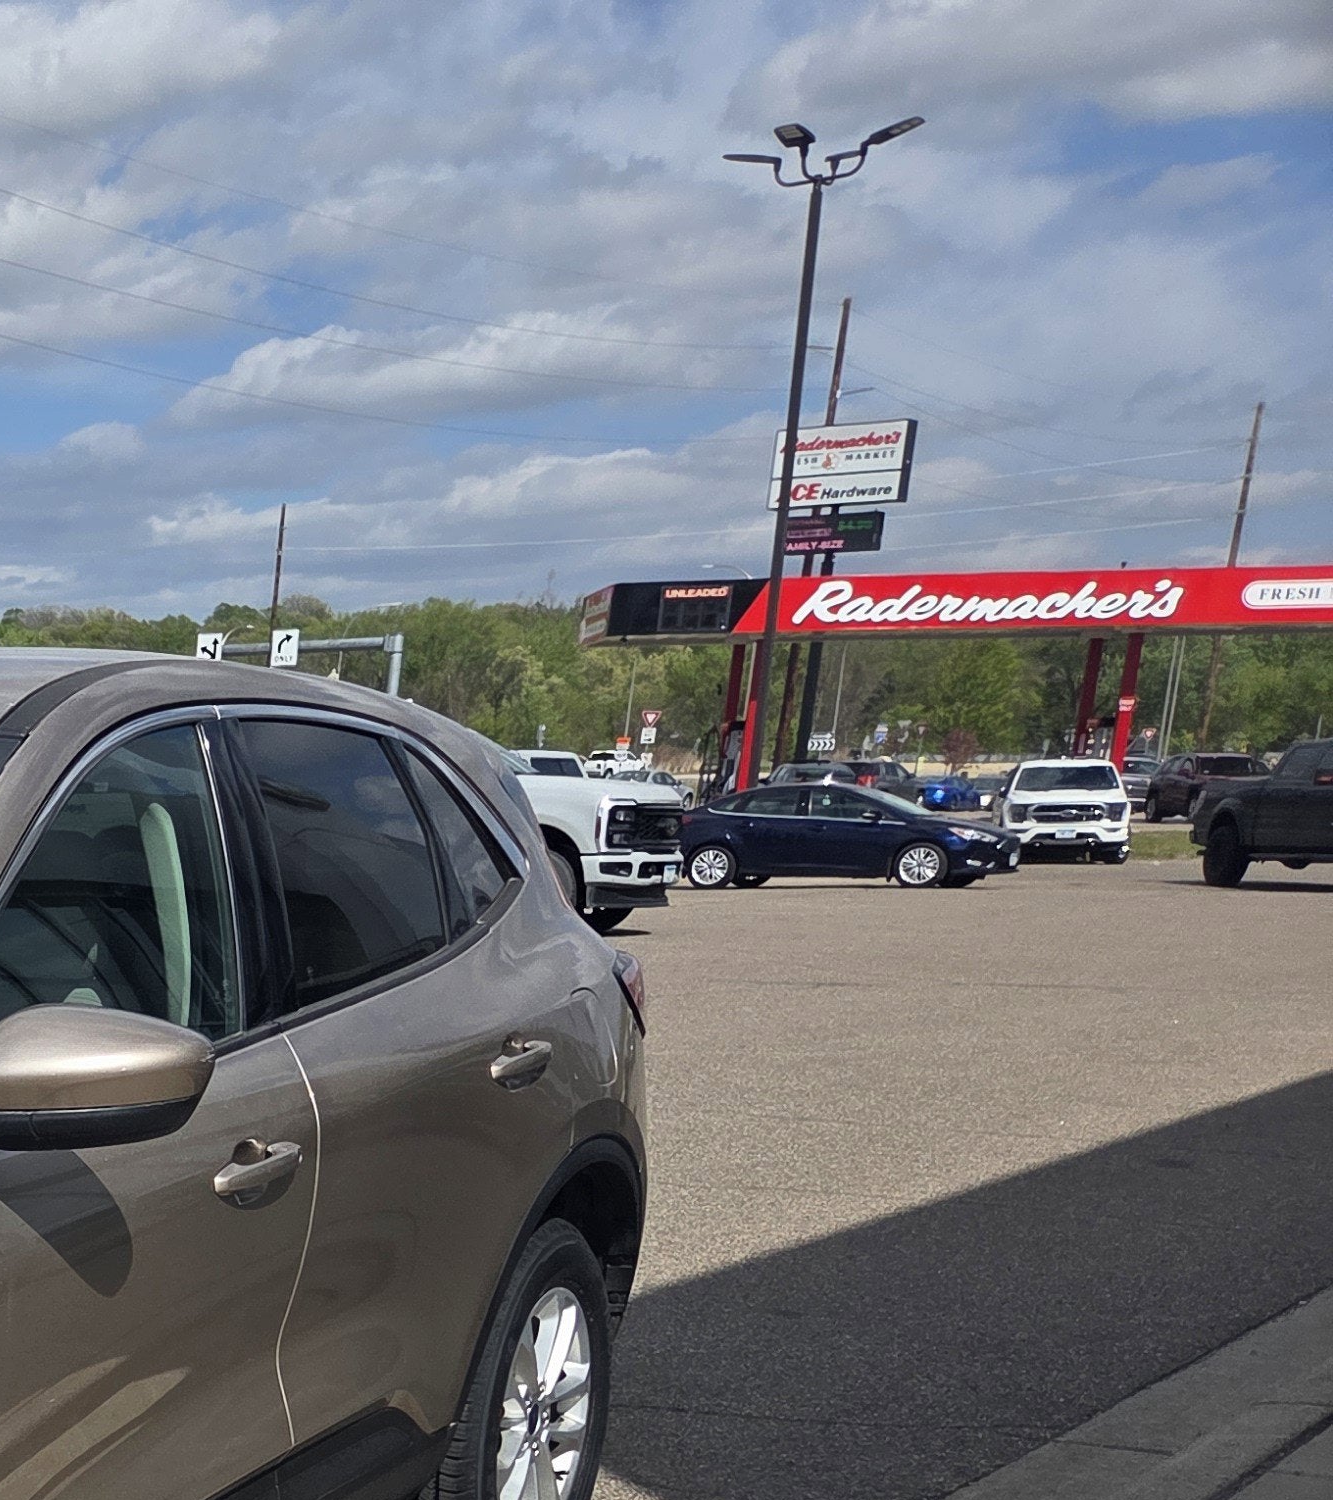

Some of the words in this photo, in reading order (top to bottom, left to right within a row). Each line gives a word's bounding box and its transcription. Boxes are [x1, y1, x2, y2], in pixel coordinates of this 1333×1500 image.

[845, 450, 895, 461] MARKET
[820, 486, 893, 500] Hardware
[785, 540, 845, 551] AMILY-SIZE
[665, 586, 729, 598] UNLEADED
[1259, 587, 1321, 600] FRESH
[792, 578, 1184, 625] Radermacher's
[274, 655, 293, 663] ONLY
